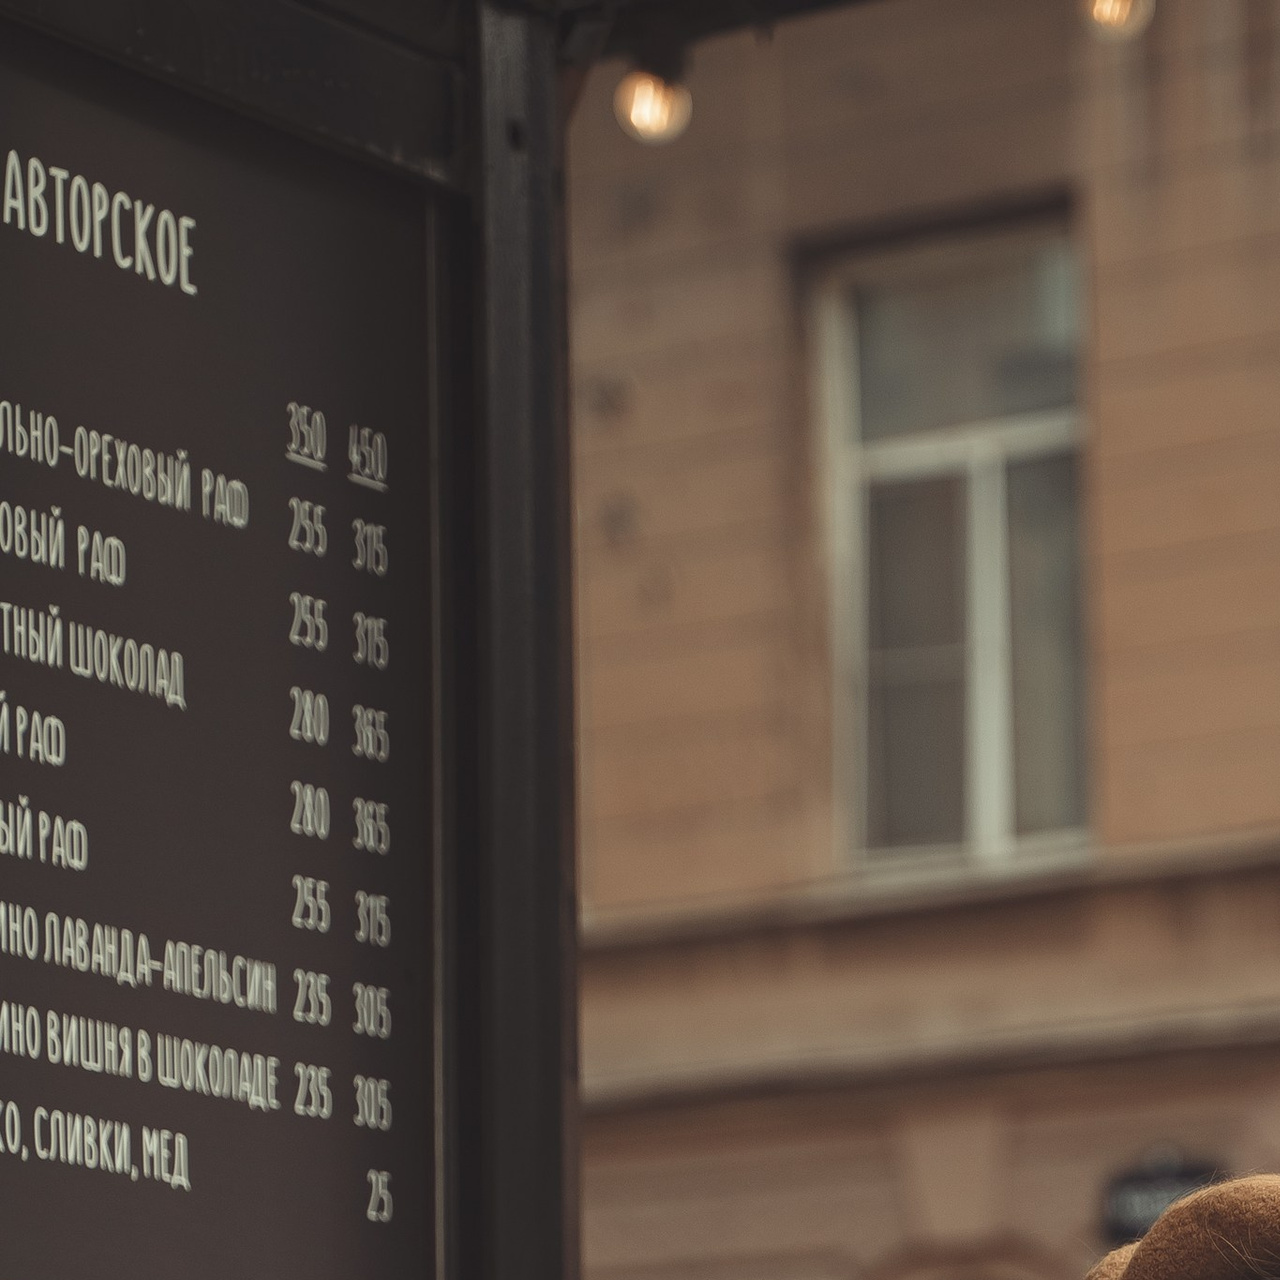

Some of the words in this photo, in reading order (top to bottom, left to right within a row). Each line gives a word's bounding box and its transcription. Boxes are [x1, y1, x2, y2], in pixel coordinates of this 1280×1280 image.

[3, 149, 198, 295] АВТОРСКОЕ
[286, 401, 328, 462] 350
[348, 423, 388, 481] 450
[202, 468, 249, 528] РАФ
[288, 497, 328, 557] 255
[0, 501, 65, 569] ОВЫЙ
[77, 524, 126, 586] РАФ
[288, 592, 328, 651] 255
[69, 621, 188, 712] ШОКОЛАД
[290, 686, 330, 746] 280
[352, 704, 390, 763] 365
[16, 705, 66, 767] РАФ
[290, 780, 330, 840] 280
[353, 797, 390, 855] 365
[38, 810, 89, 871] РАФ
[291, 874, 331, 933] 255
[44, 912, 277, 1015] ЛАВАНДА-АПЕЛЬСИН
[293, 968, 332, 1027] 235
[352, 982, 391, 1040] 305
[47, 1009, 132, 1078] ВИШНЯ
[137, 1029, 152, 1082] В
[157, 1032, 281, 1113] ШОКОЛАДЕ
[294, 1061, 332, 1120] 235
[353, 1074, 392, 1131] 305
[366, 1168, 393, 1223] 25
